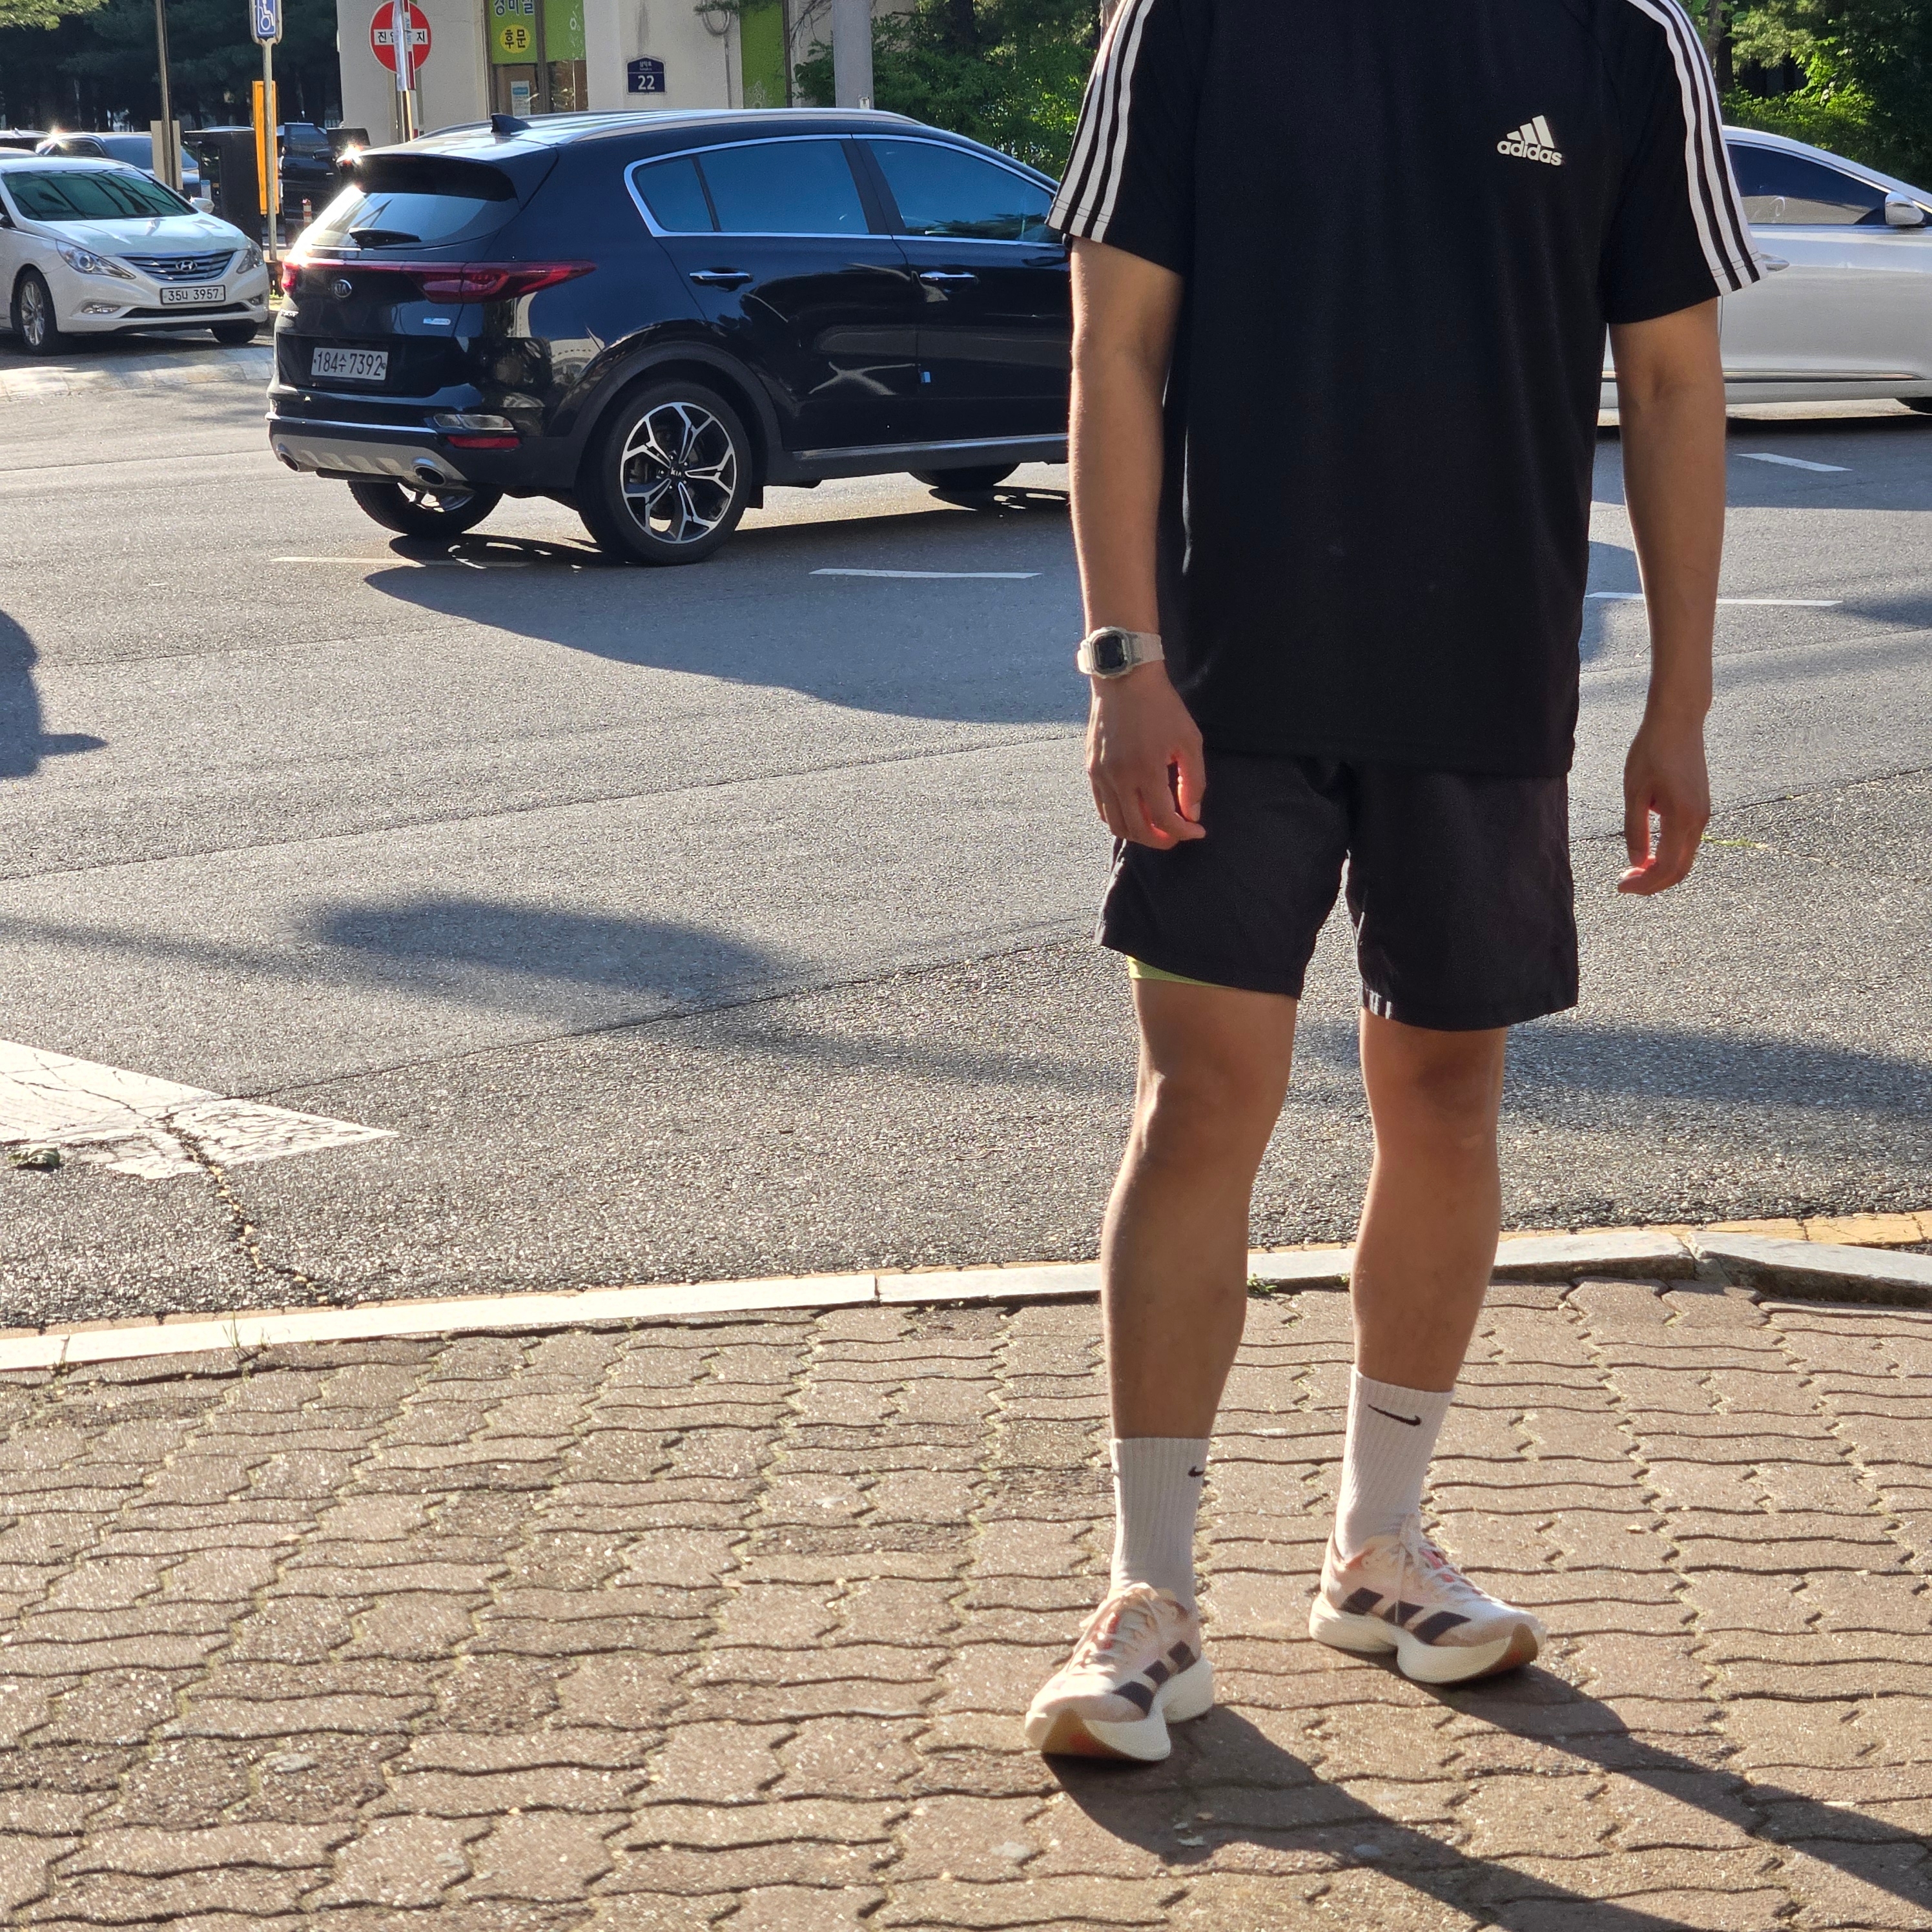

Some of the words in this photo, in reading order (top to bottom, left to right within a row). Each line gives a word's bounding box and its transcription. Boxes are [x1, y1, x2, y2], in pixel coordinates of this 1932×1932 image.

[505, 29, 526, 49] 후문
[638, 75, 655, 90] 22
[1497, 140, 1563, 166] adidas
[193, 288, 219, 300] 3957
